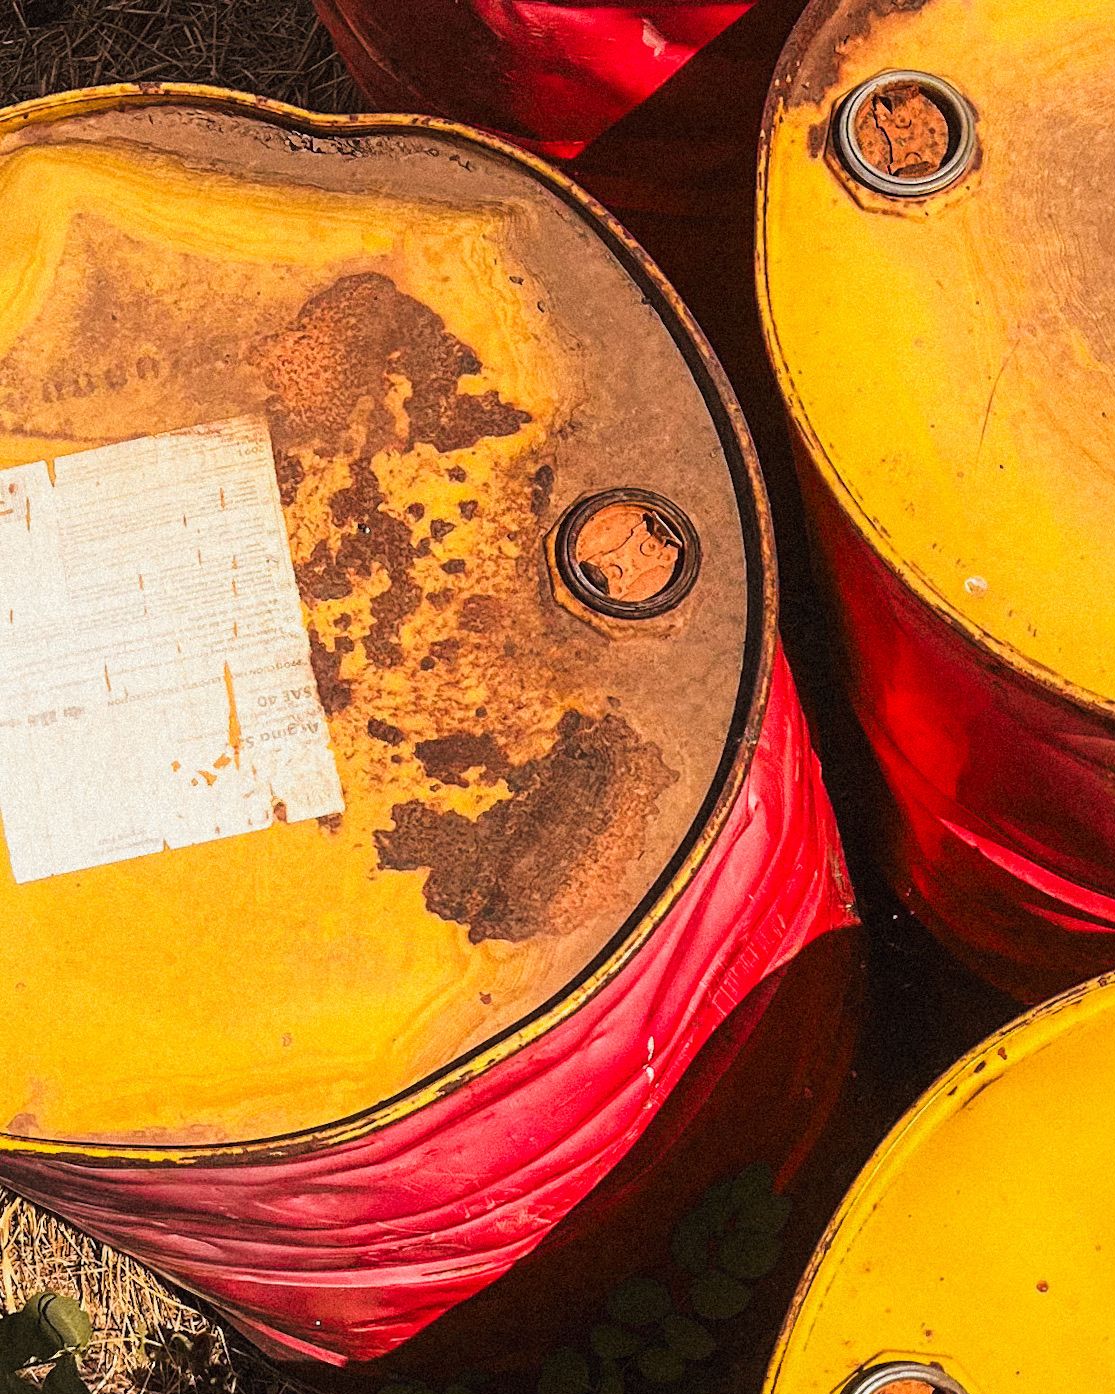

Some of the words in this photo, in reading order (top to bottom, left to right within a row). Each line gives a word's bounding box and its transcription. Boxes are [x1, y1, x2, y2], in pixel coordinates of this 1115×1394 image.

[257, 694, 277, 707] 40
[283, 686, 312, 701] SAE
[260, 721, 319, 742] Argina
